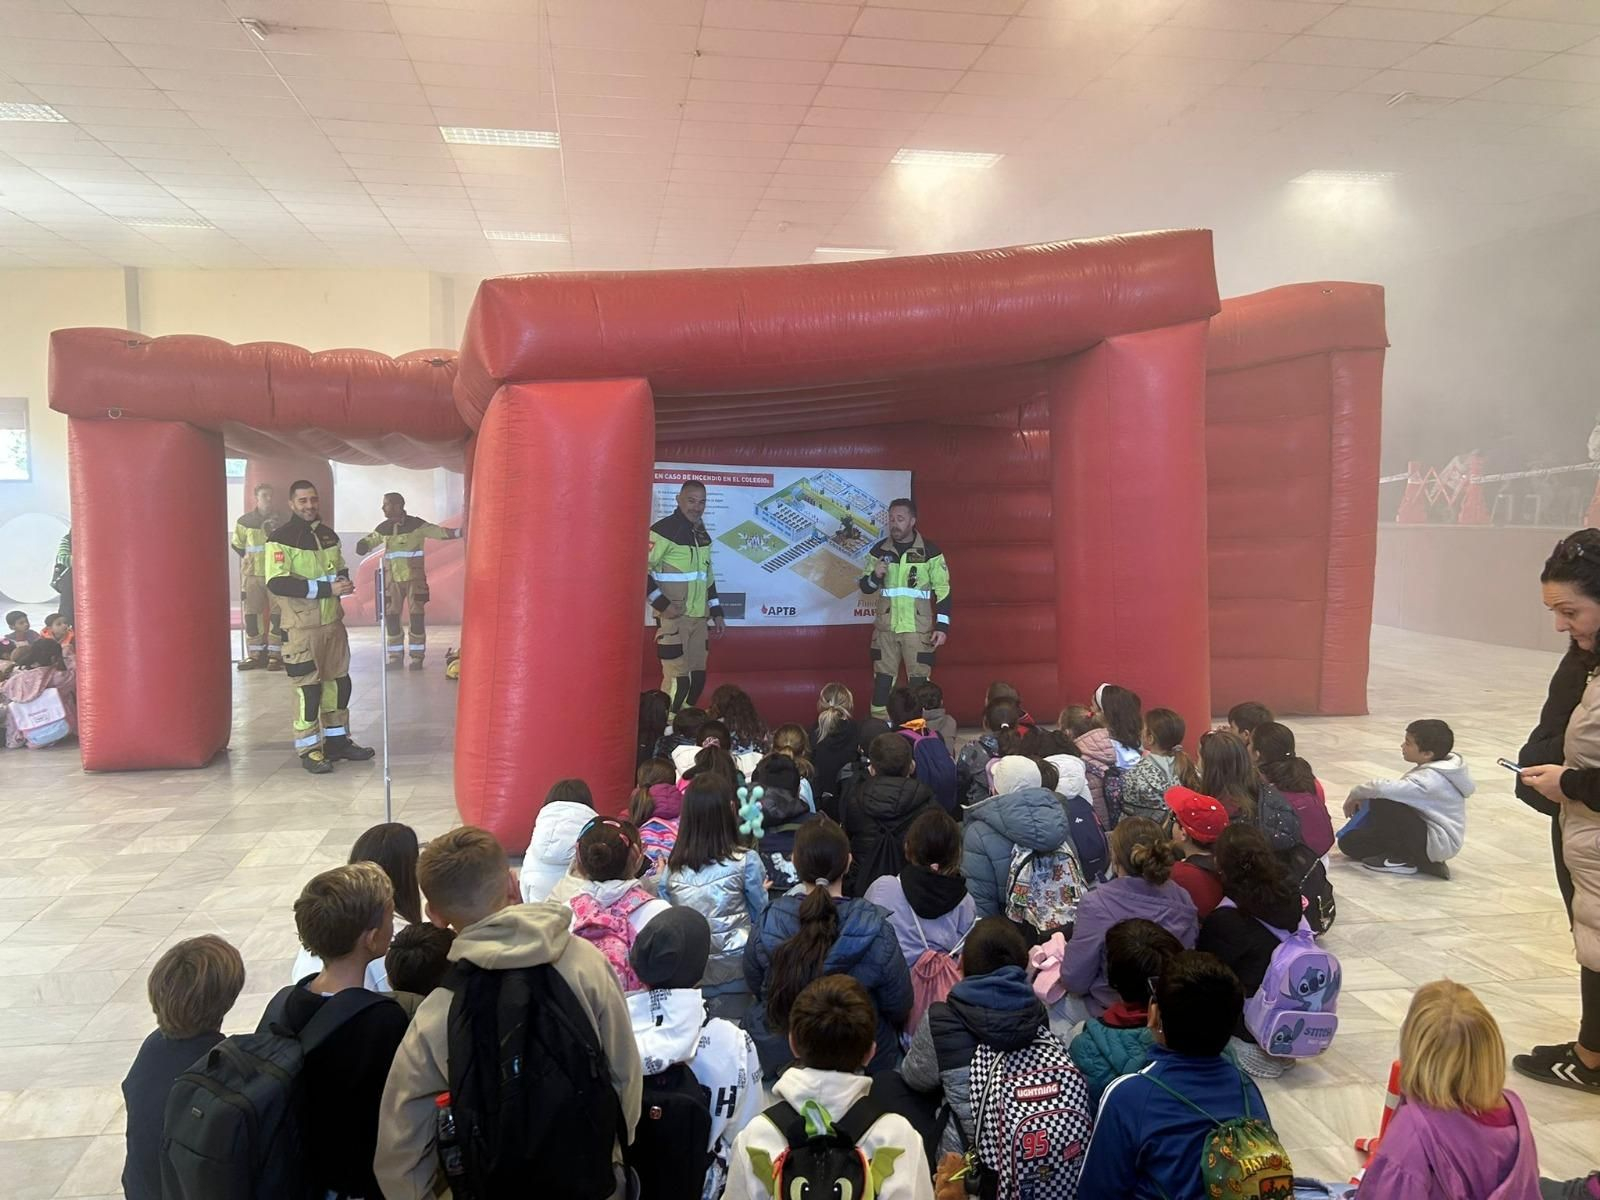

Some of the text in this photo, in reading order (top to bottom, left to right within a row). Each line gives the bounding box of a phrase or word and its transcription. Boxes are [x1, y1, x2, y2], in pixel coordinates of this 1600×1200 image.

[768, 606, 796, 616] APTB
[853, 608, 877, 617] MAP
[1016, 1083, 1058, 1097] LIGHTNING
[1022, 1129, 1049, 1160] 95
